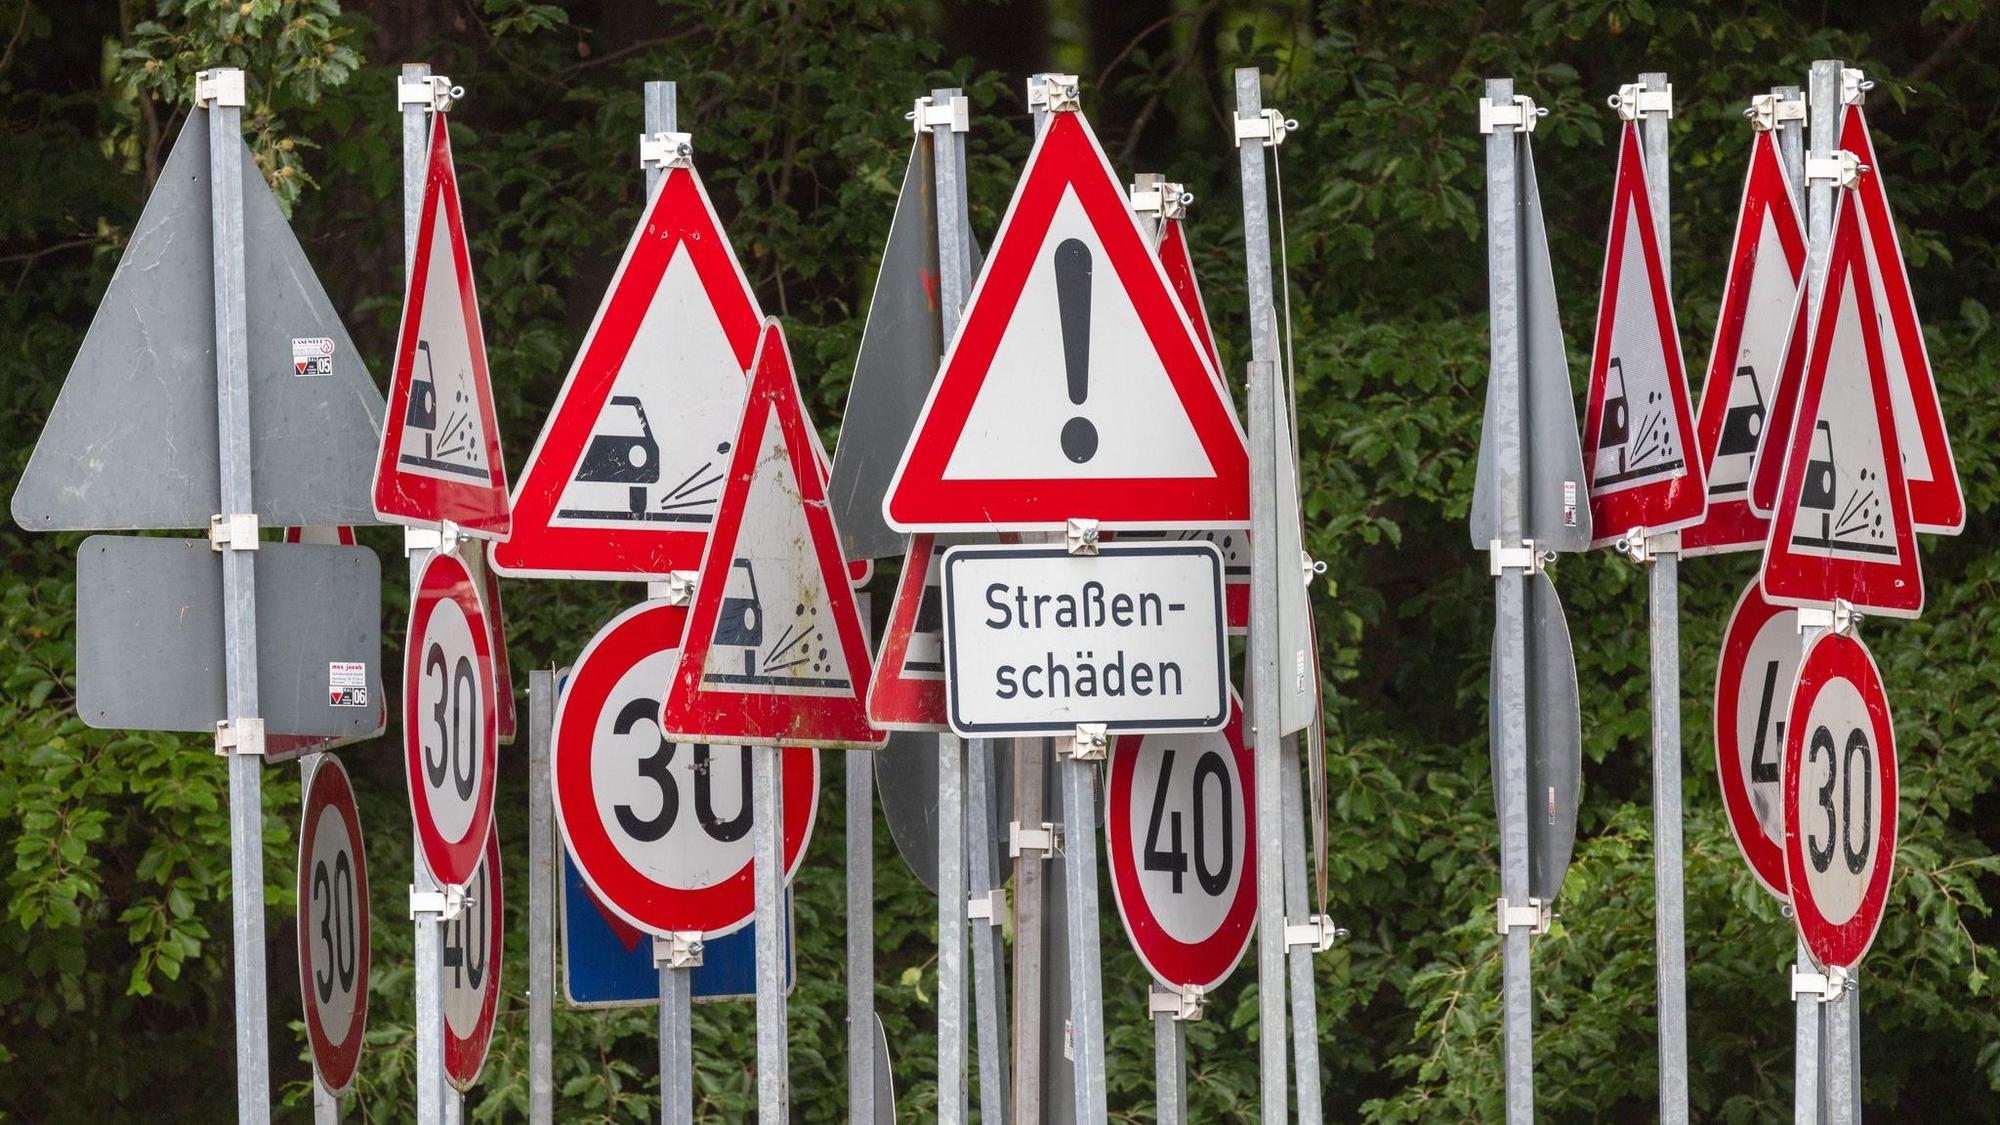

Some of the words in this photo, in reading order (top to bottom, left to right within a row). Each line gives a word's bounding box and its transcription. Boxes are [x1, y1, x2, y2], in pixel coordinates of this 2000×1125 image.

[319, 358, 330, 373] 05
[985, 581, 1186, 630] Straßen-
[996, 650, 1182, 700] schäden
[354, 689, 366, 704] 06
[425, 642, 476, 802] 30
[1752, 661, 1786, 808] 4
[613, 698, 754, 843] 30
[1144, 750, 1233, 897] 40
[1807, 725, 1872, 875] 30
[314, 850, 355, 1005] 30
